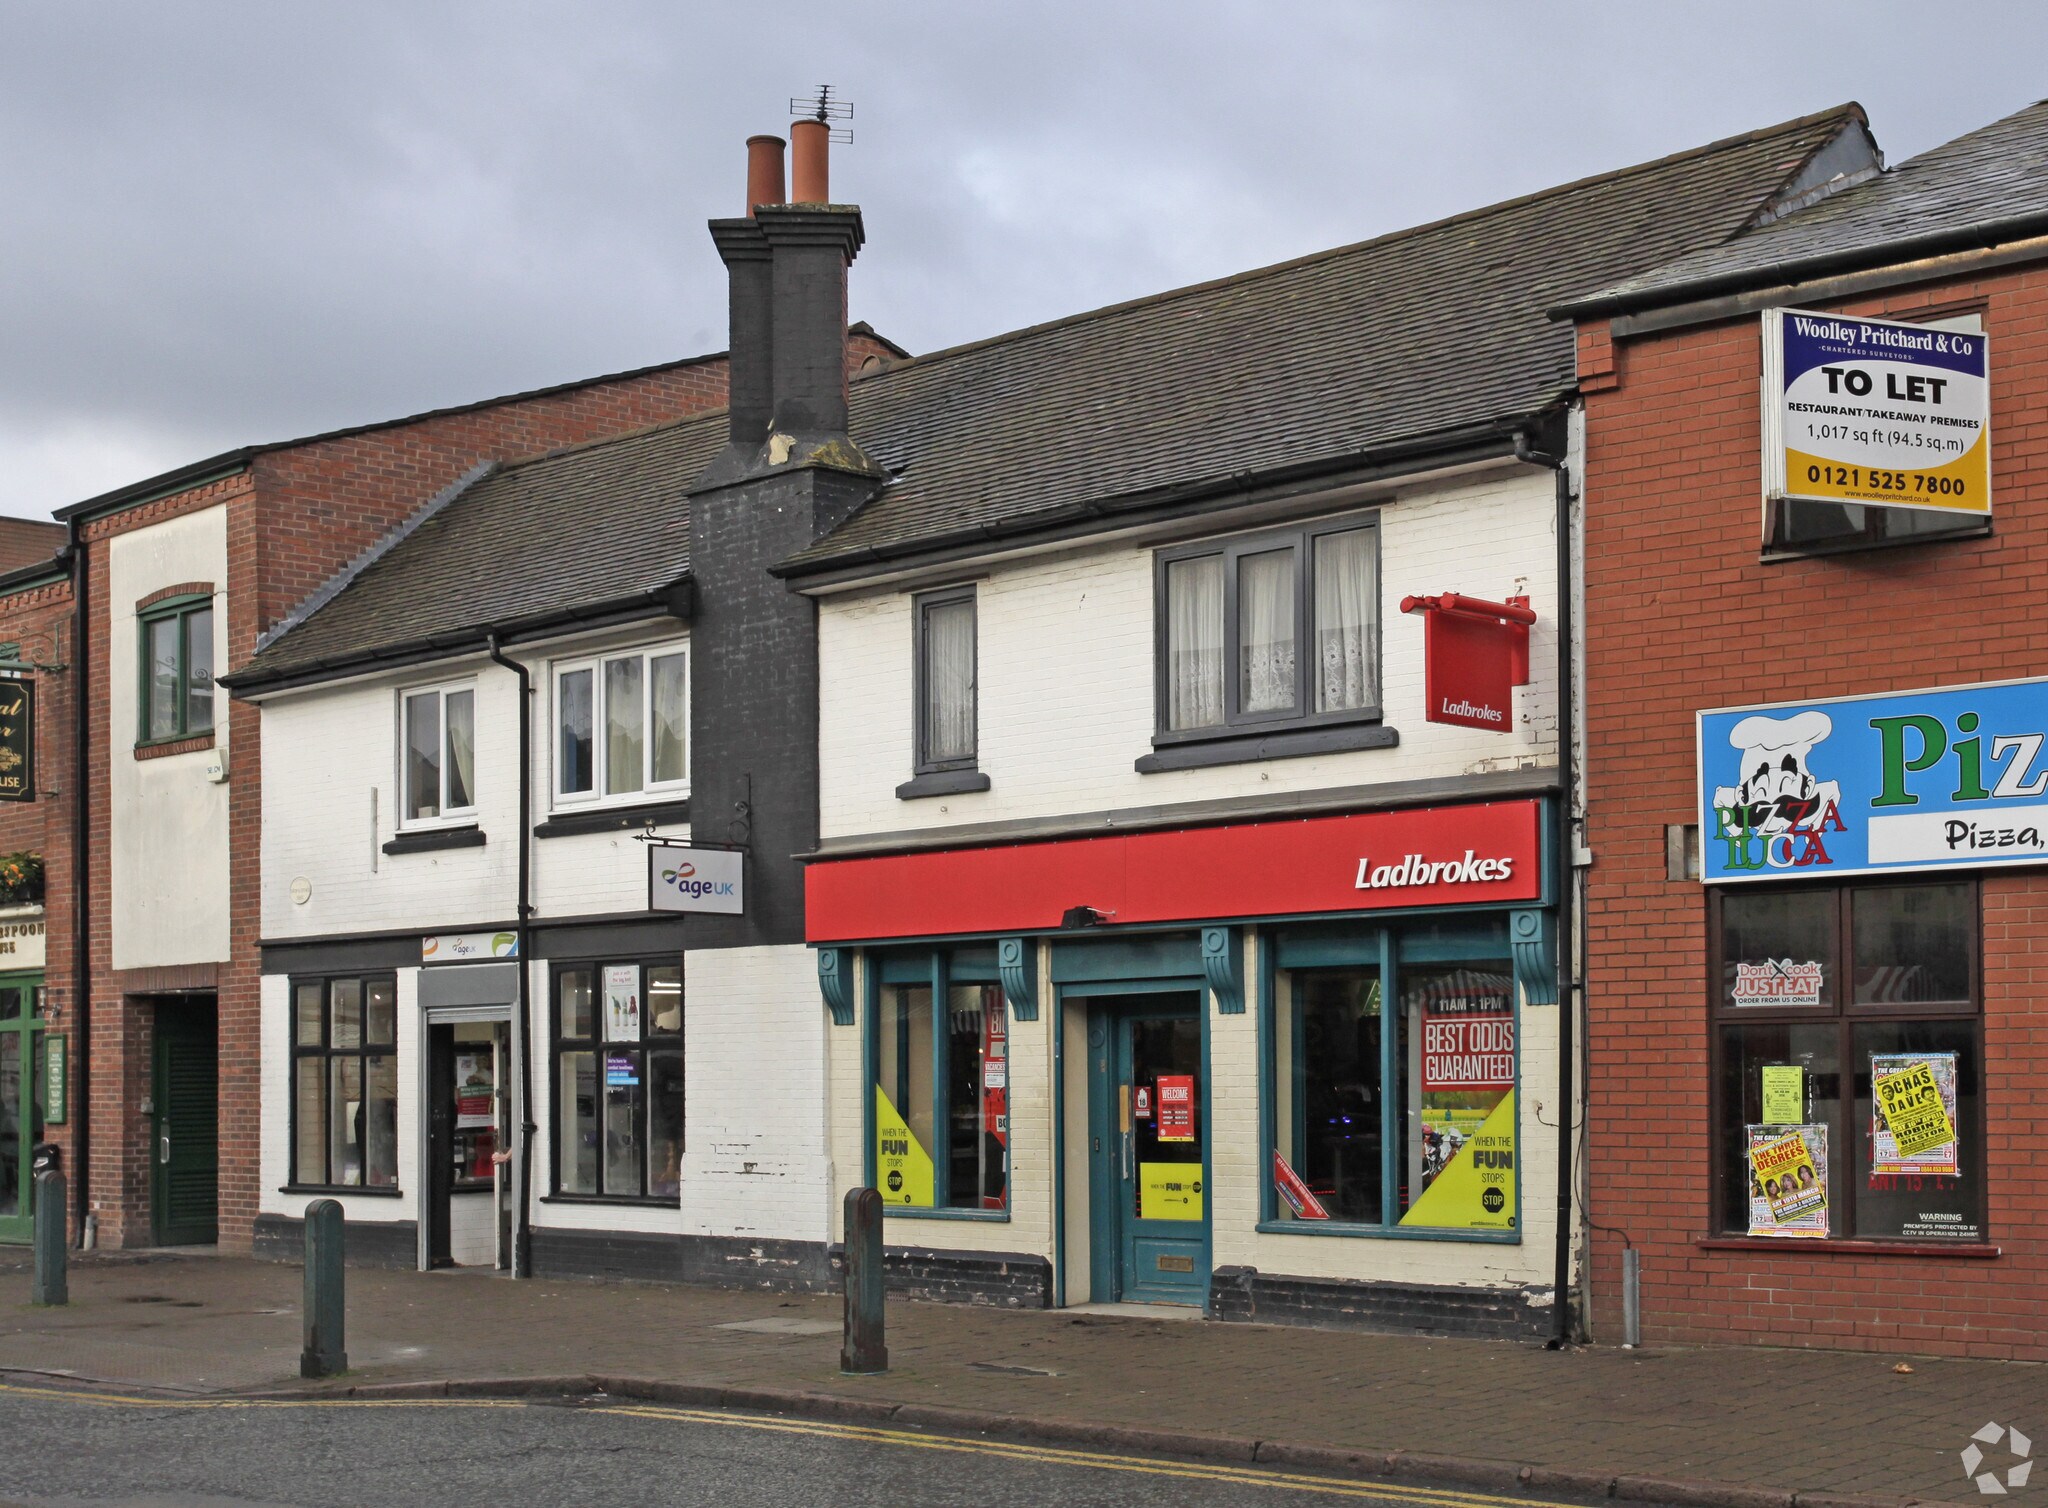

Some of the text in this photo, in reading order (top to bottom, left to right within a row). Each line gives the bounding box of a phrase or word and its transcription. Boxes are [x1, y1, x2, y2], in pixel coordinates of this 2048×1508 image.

[1794, 316, 1973, 356] Woolley Pritchard & Co
[1821, 366, 1947, 405] TO LET
[1788, 402, 1979, 429] RESTAURANT/TAKEAWAY PREMISES
[1807, 424, 1964, 454] 1,017 sq ft (94.5 sq.m)
[1807, 464, 1965, 496] 0121 525 7800
[1844, 490, 1931, 504] www.woolleypritchard.co.uk
[1441, 696, 1503, 723] Ladbrokes
[1713, 799, 1848, 840] PIZZA
[1943, 819, 2046, 850] Pizza,
[1354, 850, 1513, 890] Ladbrokes
[678, 880, 734, 899] age UK
[1740, 962, 1818, 976] Don't cook
[1736, 977, 1819, 996] JUST EAT
[1439, 998, 1467, 1011] 11AM
[1479, 996, 1501, 1010] 1PM
[1425, 1021, 1515, 1053] BEST ODDS
[1425, 1053, 1515, 1081] GUARANTEED
[1892, 1070, 1931, 1094] CHAS
[1139, 1098, 1146, 1106] 18
[1162, 1088, 1188, 1099] WELCOME
[1887, 1093, 1923, 1115] DAVE
[882, 1128, 907, 1137] WHEN THE
[1895, 1121, 1935, 1139] ROBIN
[1900, 1126, 1946, 1146] BILSTON
[881, 1139, 909, 1156] FUN
[1474, 1136, 1511, 1147] WHEN THE
[1754, 1149, 1771, 1161] THE
[1772, 1139, 1801, 1154] THREE
[886, 1158, 904, 1167] STOPS
[1473, 1150, 1513, 1170] FUN
[1756, 1145, 1805, 1172] DEGREES
[888, 1176, 902, 1186] STOP
[1165, 1182, 1182, 1191] FUN
[1481, 1173, 1505, 1184] STOPS
[1483, 1194, 1503, 1206] STOP
[1918, 1212, 1963, 1221] WARNING
